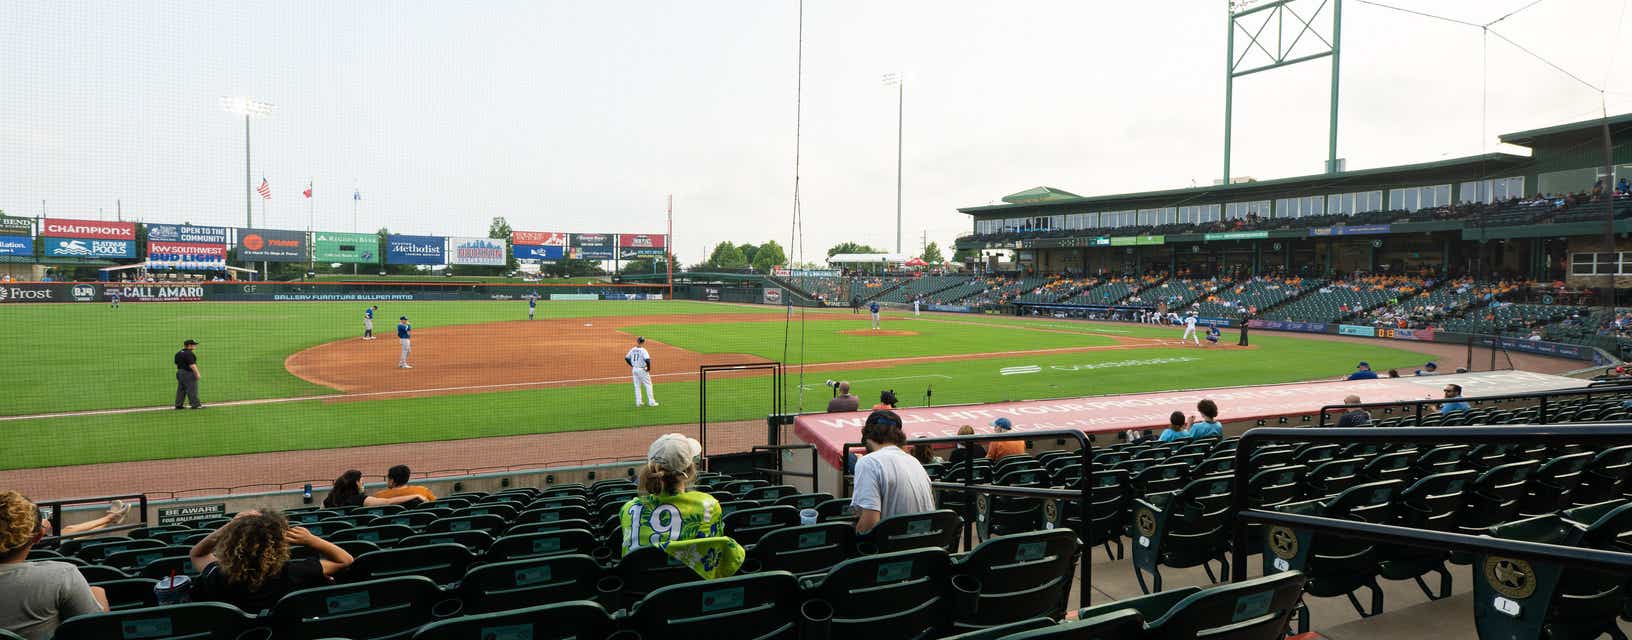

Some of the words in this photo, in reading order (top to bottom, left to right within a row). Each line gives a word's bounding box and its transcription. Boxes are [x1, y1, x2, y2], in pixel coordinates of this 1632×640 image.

[181, 226, 201, 234] OPEN
[201, 227, 211, 235] TO
[211, 228, 225, 236] THE
[181, 234, 225, 242] COMMUNITY
[92, 240, 127, 248] PLATINUM
[392, 244, 441, 254] Methodist
[92, 246, 127, 254] POOLS
[171, 245, 223, 255] SOUTHWEST
[150, 253, 181, 262] BUD
[183, 254, 222, 263] LIGHT
[10, 287, 54, 299] Frost
[124, 287, 155, 298] CALL
[158, 287, 204, 298] AMARO
[994, 404, 1088, 417] YOUR
[182, 506, 218, 515] AWARE
[628, 503, 682, 551] 19
[1502, 600, 1511, 611] L
